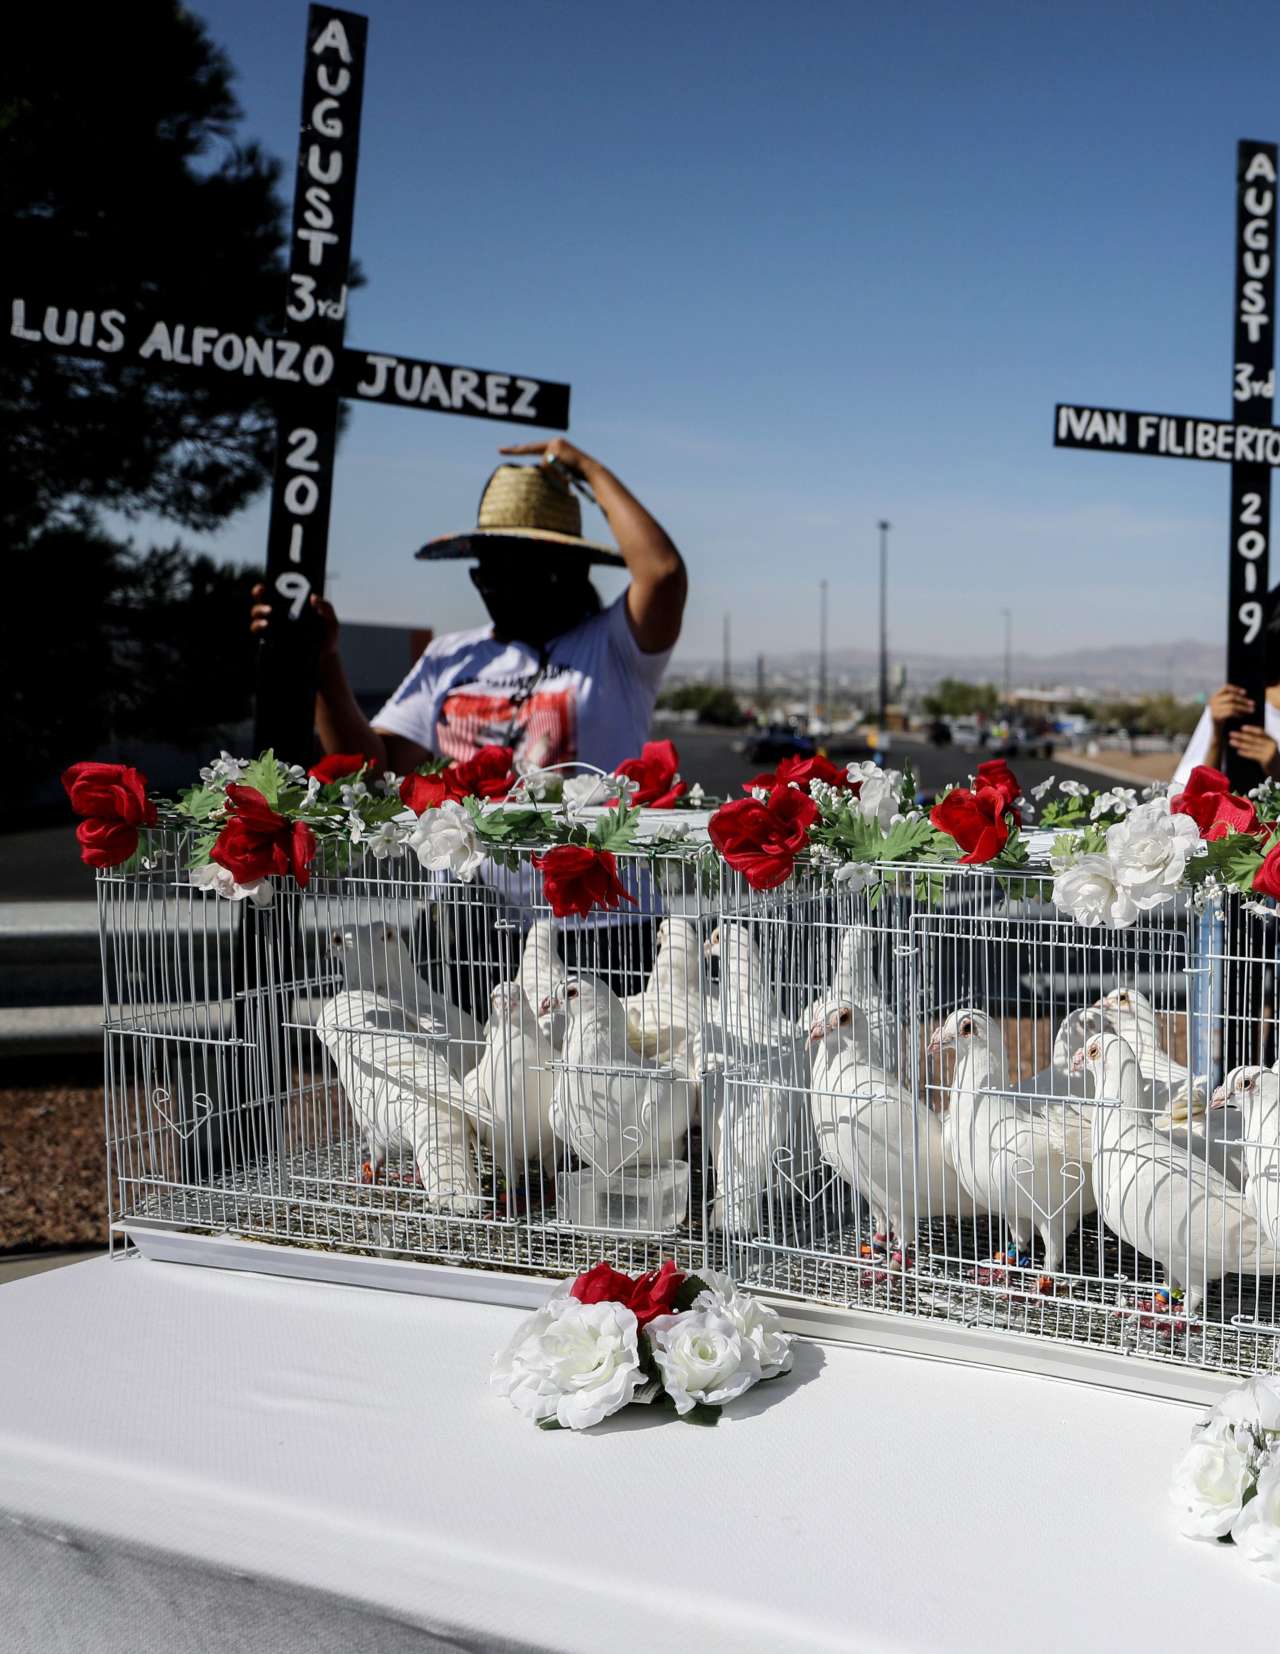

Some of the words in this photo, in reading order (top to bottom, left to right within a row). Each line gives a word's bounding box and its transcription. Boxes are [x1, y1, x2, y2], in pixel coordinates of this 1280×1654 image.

[298, 19, 353, 266] AUGUST
[287, 274, 347, 321] 3rd
[1240, 152, 1276, 343] AUGUST
[10, 299, 126, 353] LUIS
[138, 322, 334, 387] ALFONZO
[357, 355, 539, 418] JUAREZ
[1058, 406, 1127, 446] IVAN
[1233, 363, 1275, 401] 3rd
[275, 428, 320, 621] 2019
[1237, 493, 1265, 644] 2019
